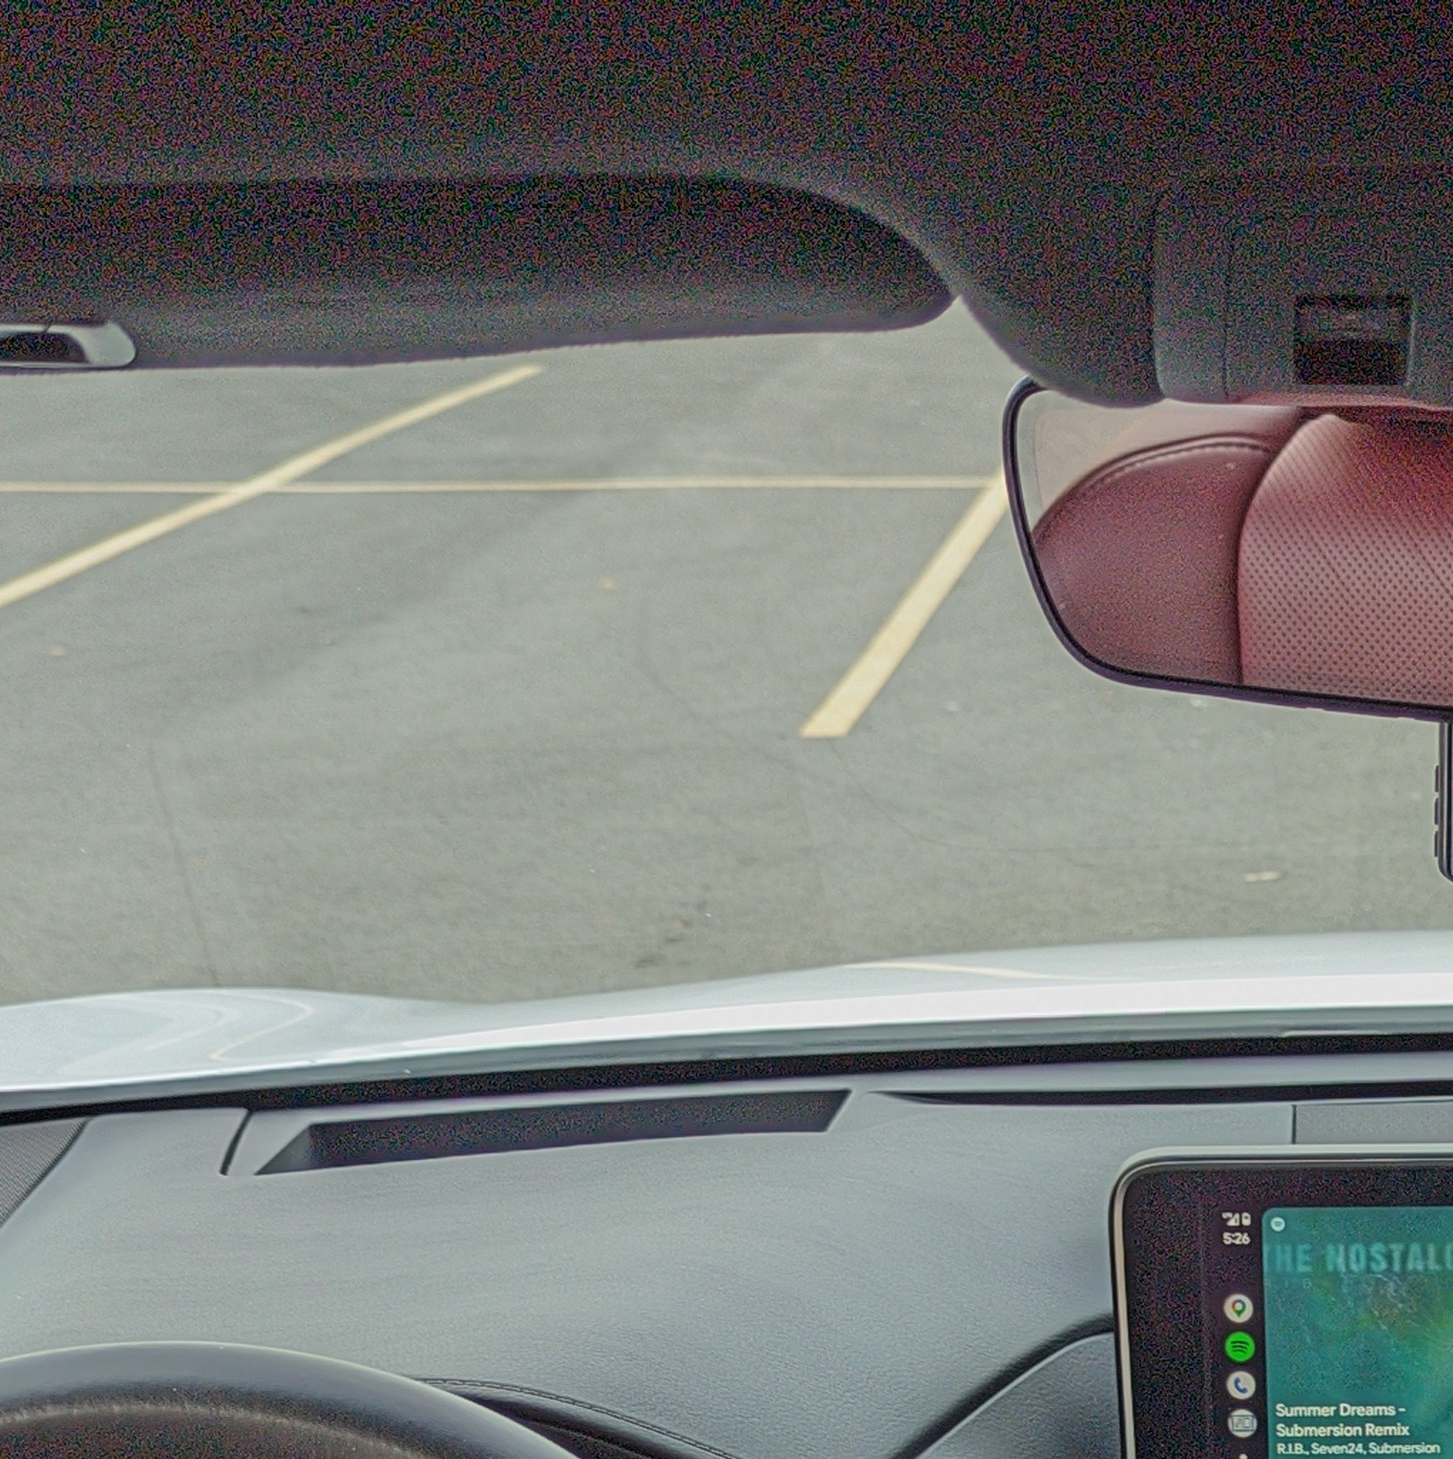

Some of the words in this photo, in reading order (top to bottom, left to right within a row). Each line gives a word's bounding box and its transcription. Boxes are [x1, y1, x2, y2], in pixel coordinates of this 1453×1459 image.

[1223, 1232, 1251, 1245] 5:26
[1275, 1403, 1336, 1417] Summer
[1339, 1403, 1396, 1416] Dreams
[1276, 1423, 1362, 1437] Submersion
[1365, 1423, 1410, 1436] Remix
[1311, 1442, 1366, 1455] Seven24,
[1368, 1442, 1440, 1454] Submersion
